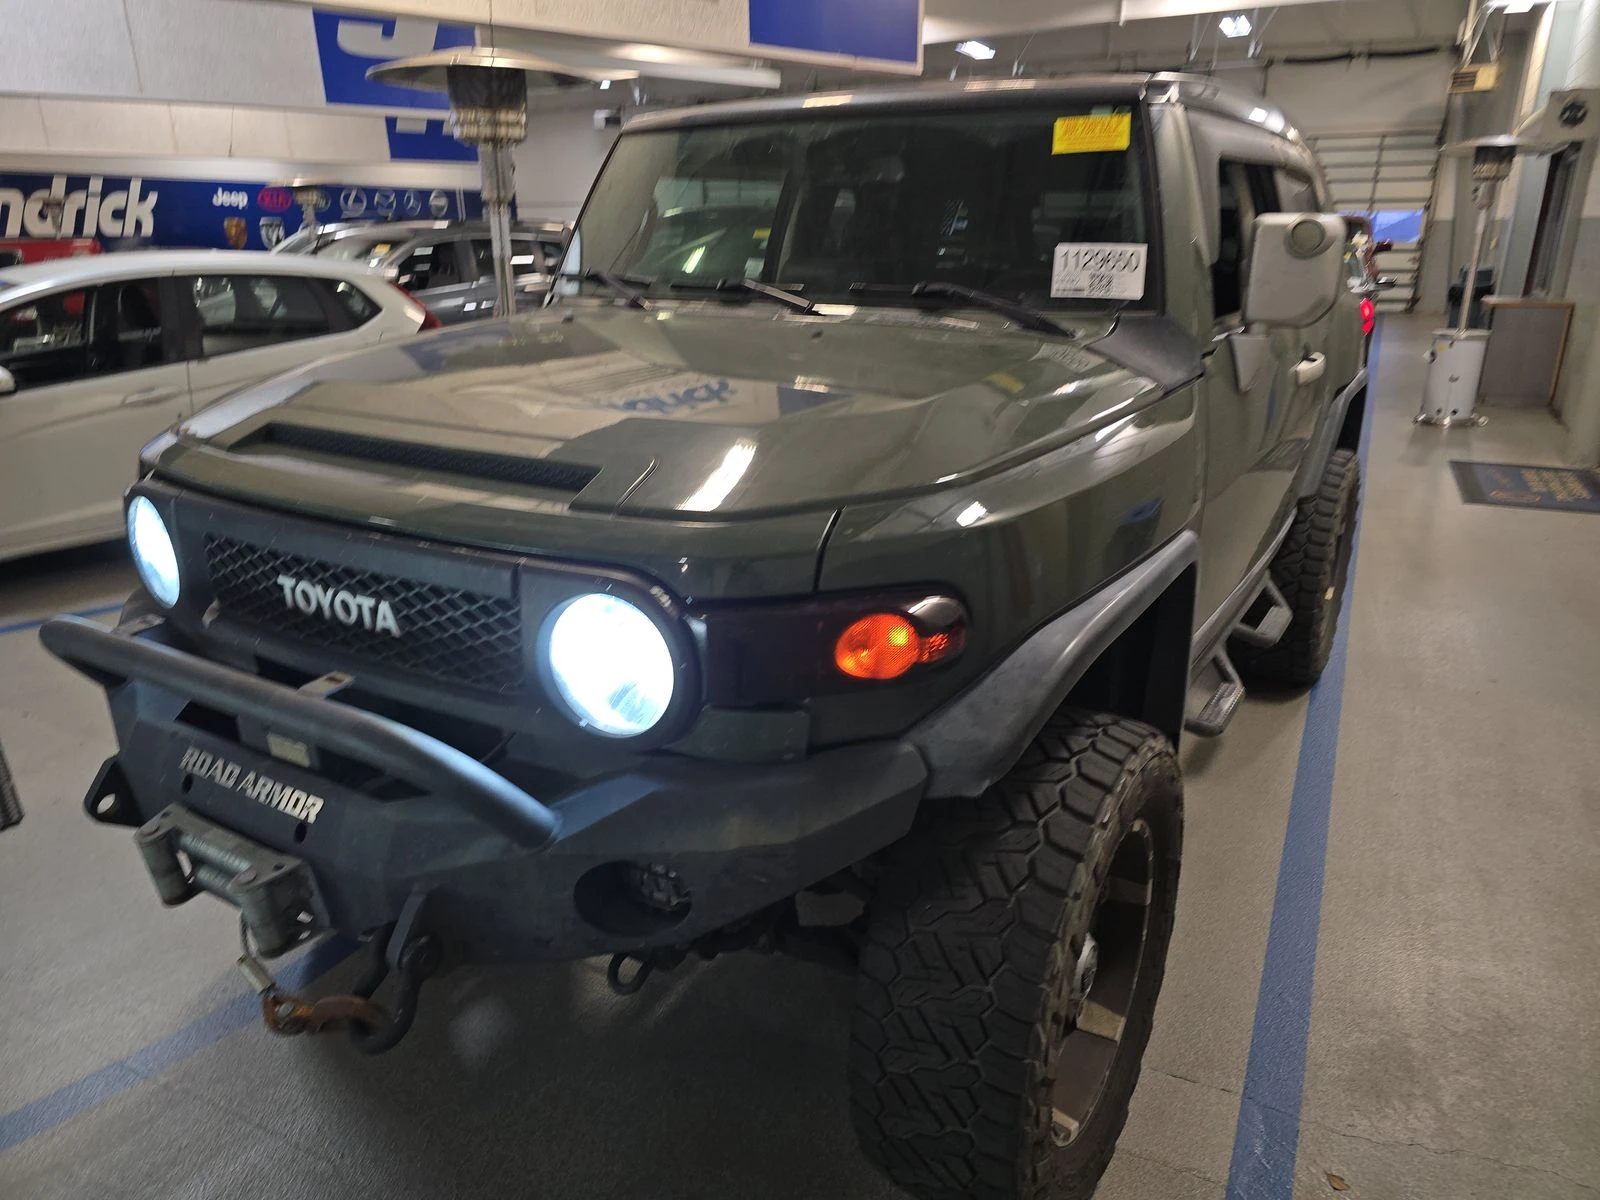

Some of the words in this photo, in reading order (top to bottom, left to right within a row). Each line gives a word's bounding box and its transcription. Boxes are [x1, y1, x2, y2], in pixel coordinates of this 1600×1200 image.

[212, 187, 248, 210] Jeep
[276, 574, 400, 638] TOYOTA
[178, 746, 242, 789] ROAD
[236, 770, 325, 825] ARMOR
